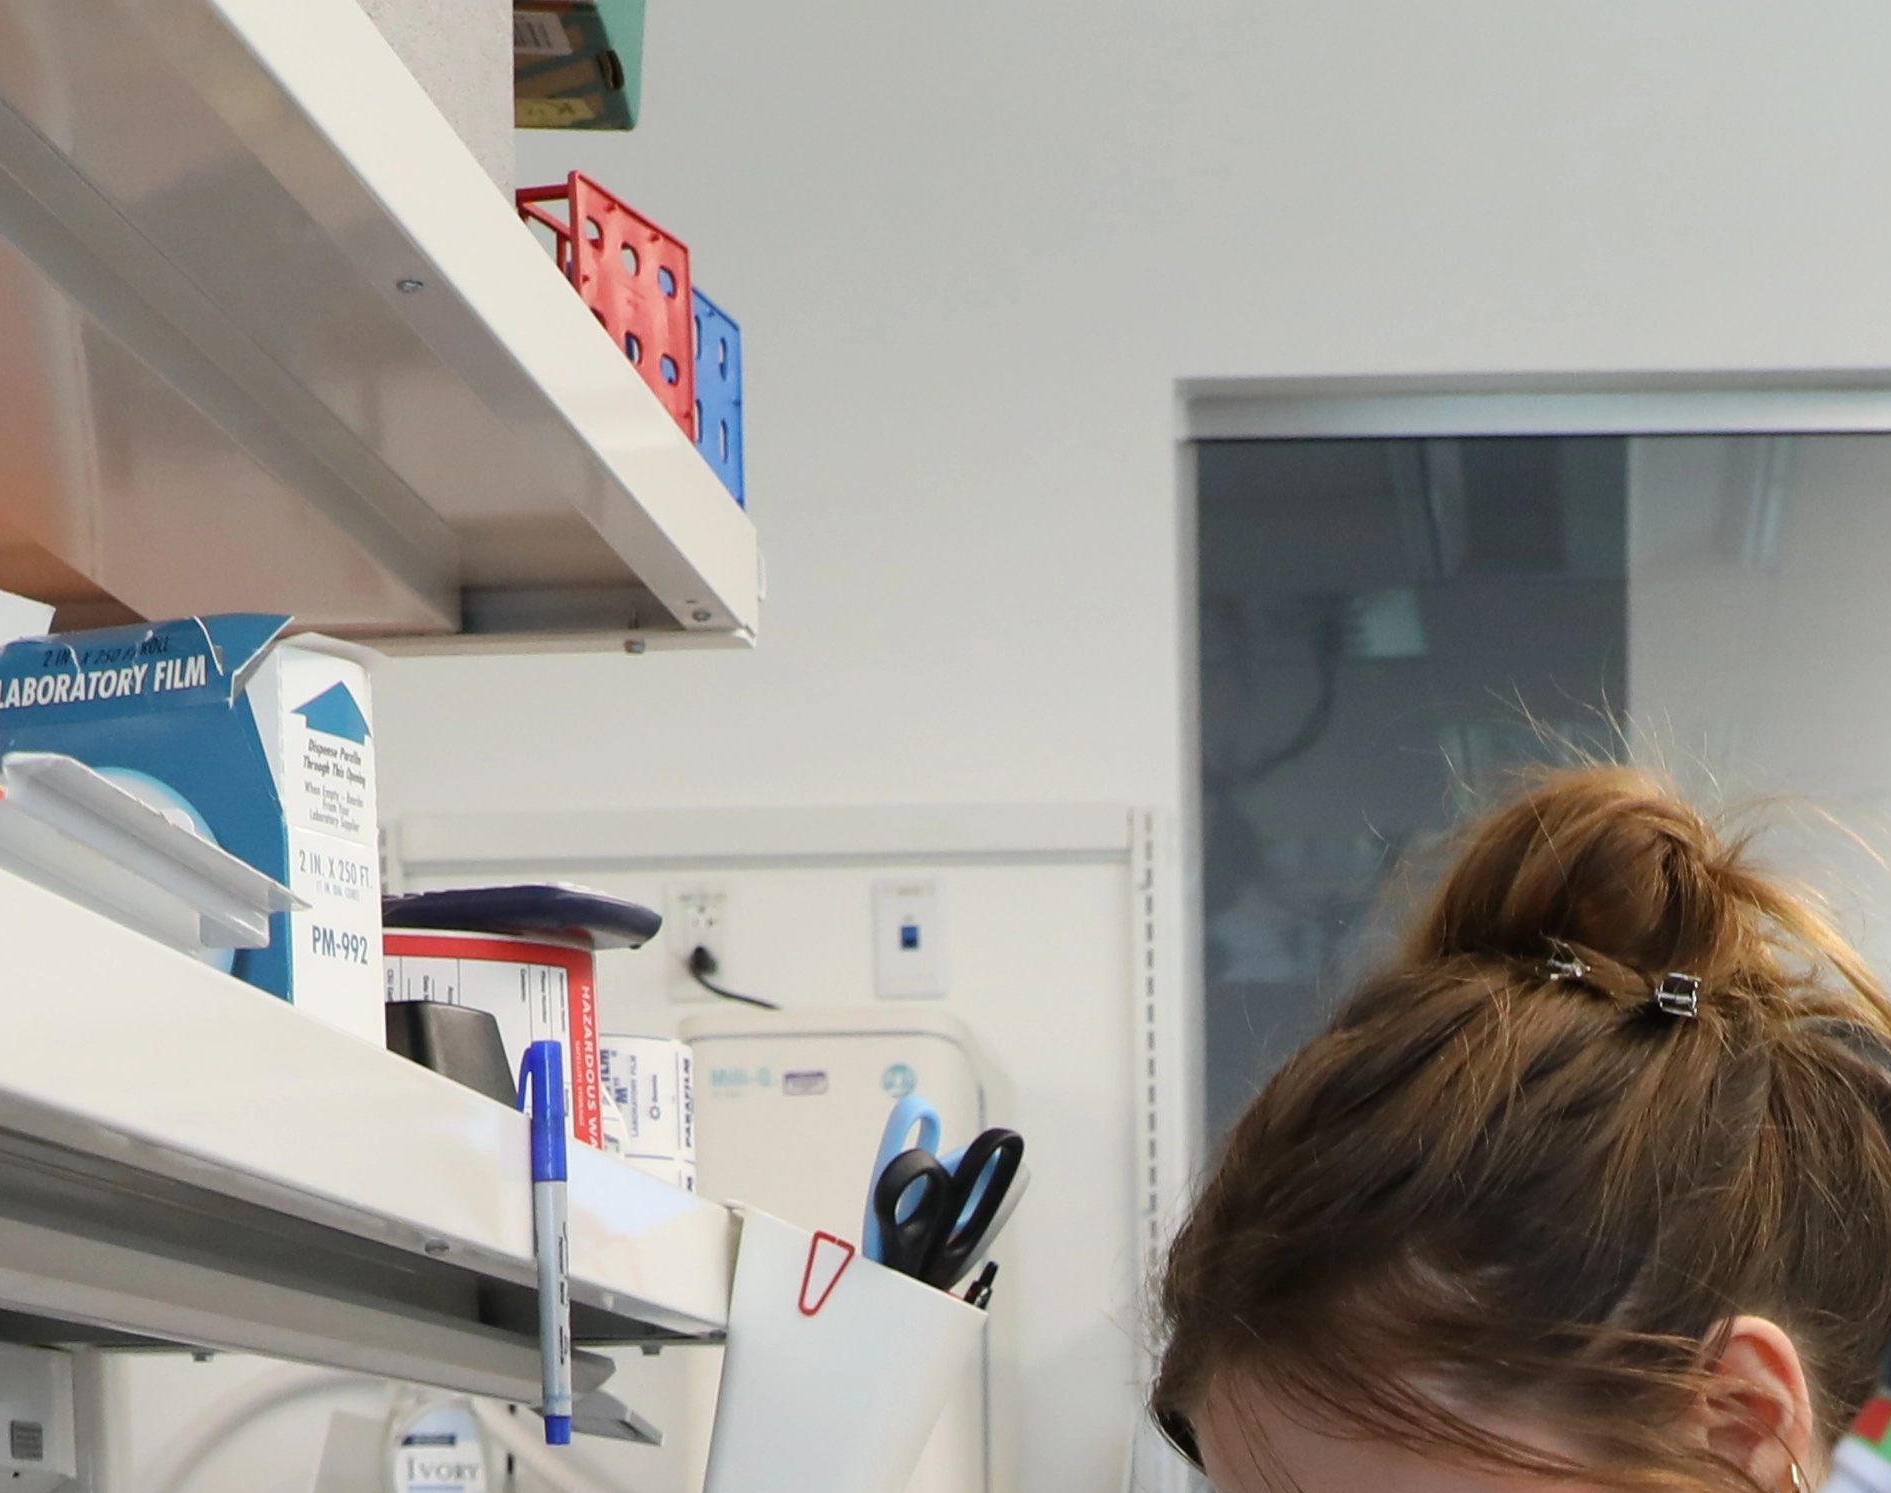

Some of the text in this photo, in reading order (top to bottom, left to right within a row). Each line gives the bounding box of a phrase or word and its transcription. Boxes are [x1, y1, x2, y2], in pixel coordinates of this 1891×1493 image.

[153, 655, 208, 693] FILM
[308, 737, 338, 759] Dispense
[303, 754, 366, 790] Through This Opening
[299, 849, 374, 889] 2 IN. X 250 FT.
[312, 925, 368, 966] PM-992
[580, 985, 597, 1111] HAZARDOUS
[407, 1456, 481, 1482] IVORY
